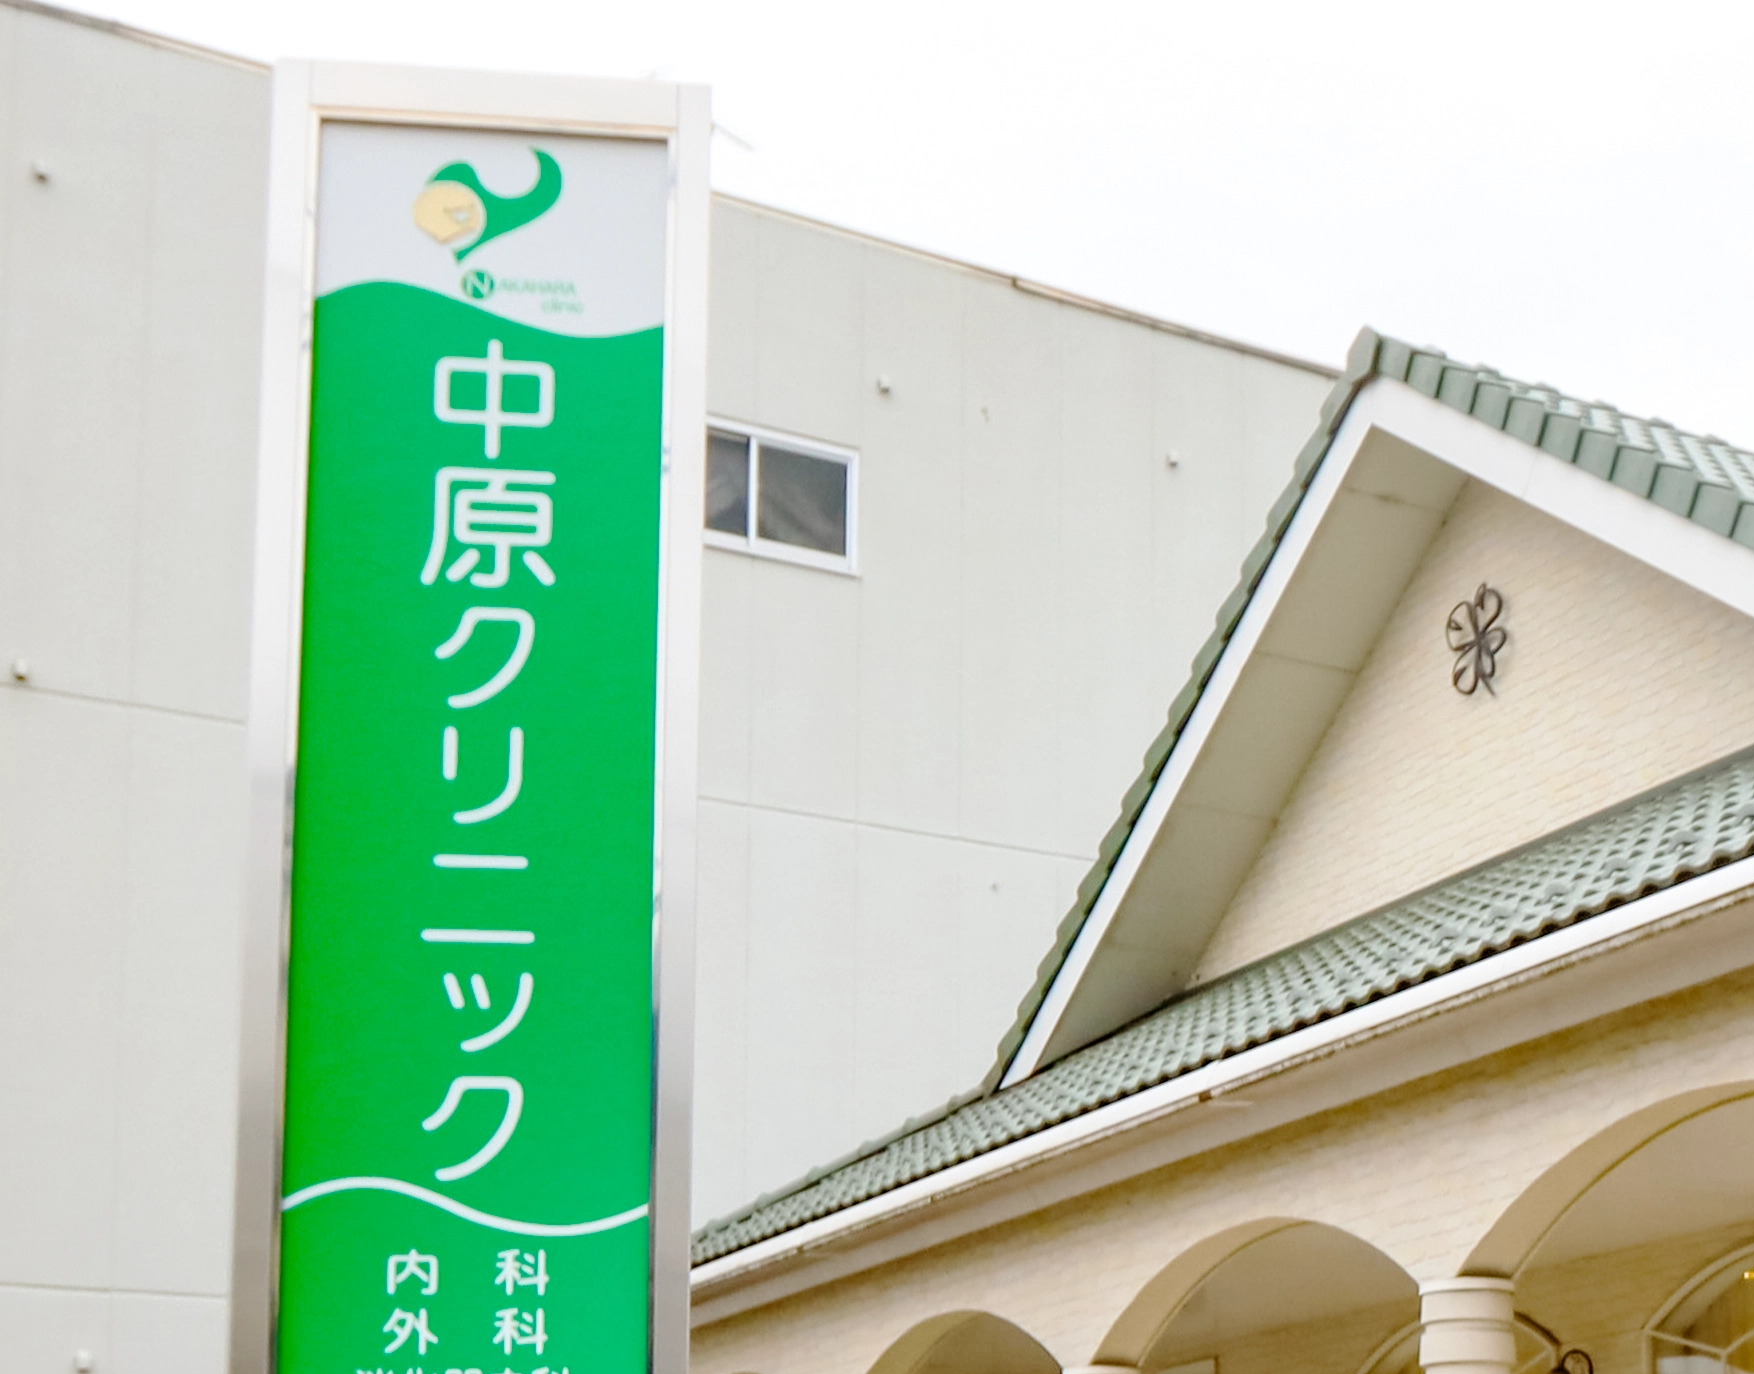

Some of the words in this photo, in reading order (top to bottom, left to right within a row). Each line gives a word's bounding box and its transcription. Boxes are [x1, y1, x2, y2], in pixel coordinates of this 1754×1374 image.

[420, 338, 557, 1182] 中原クリニック
